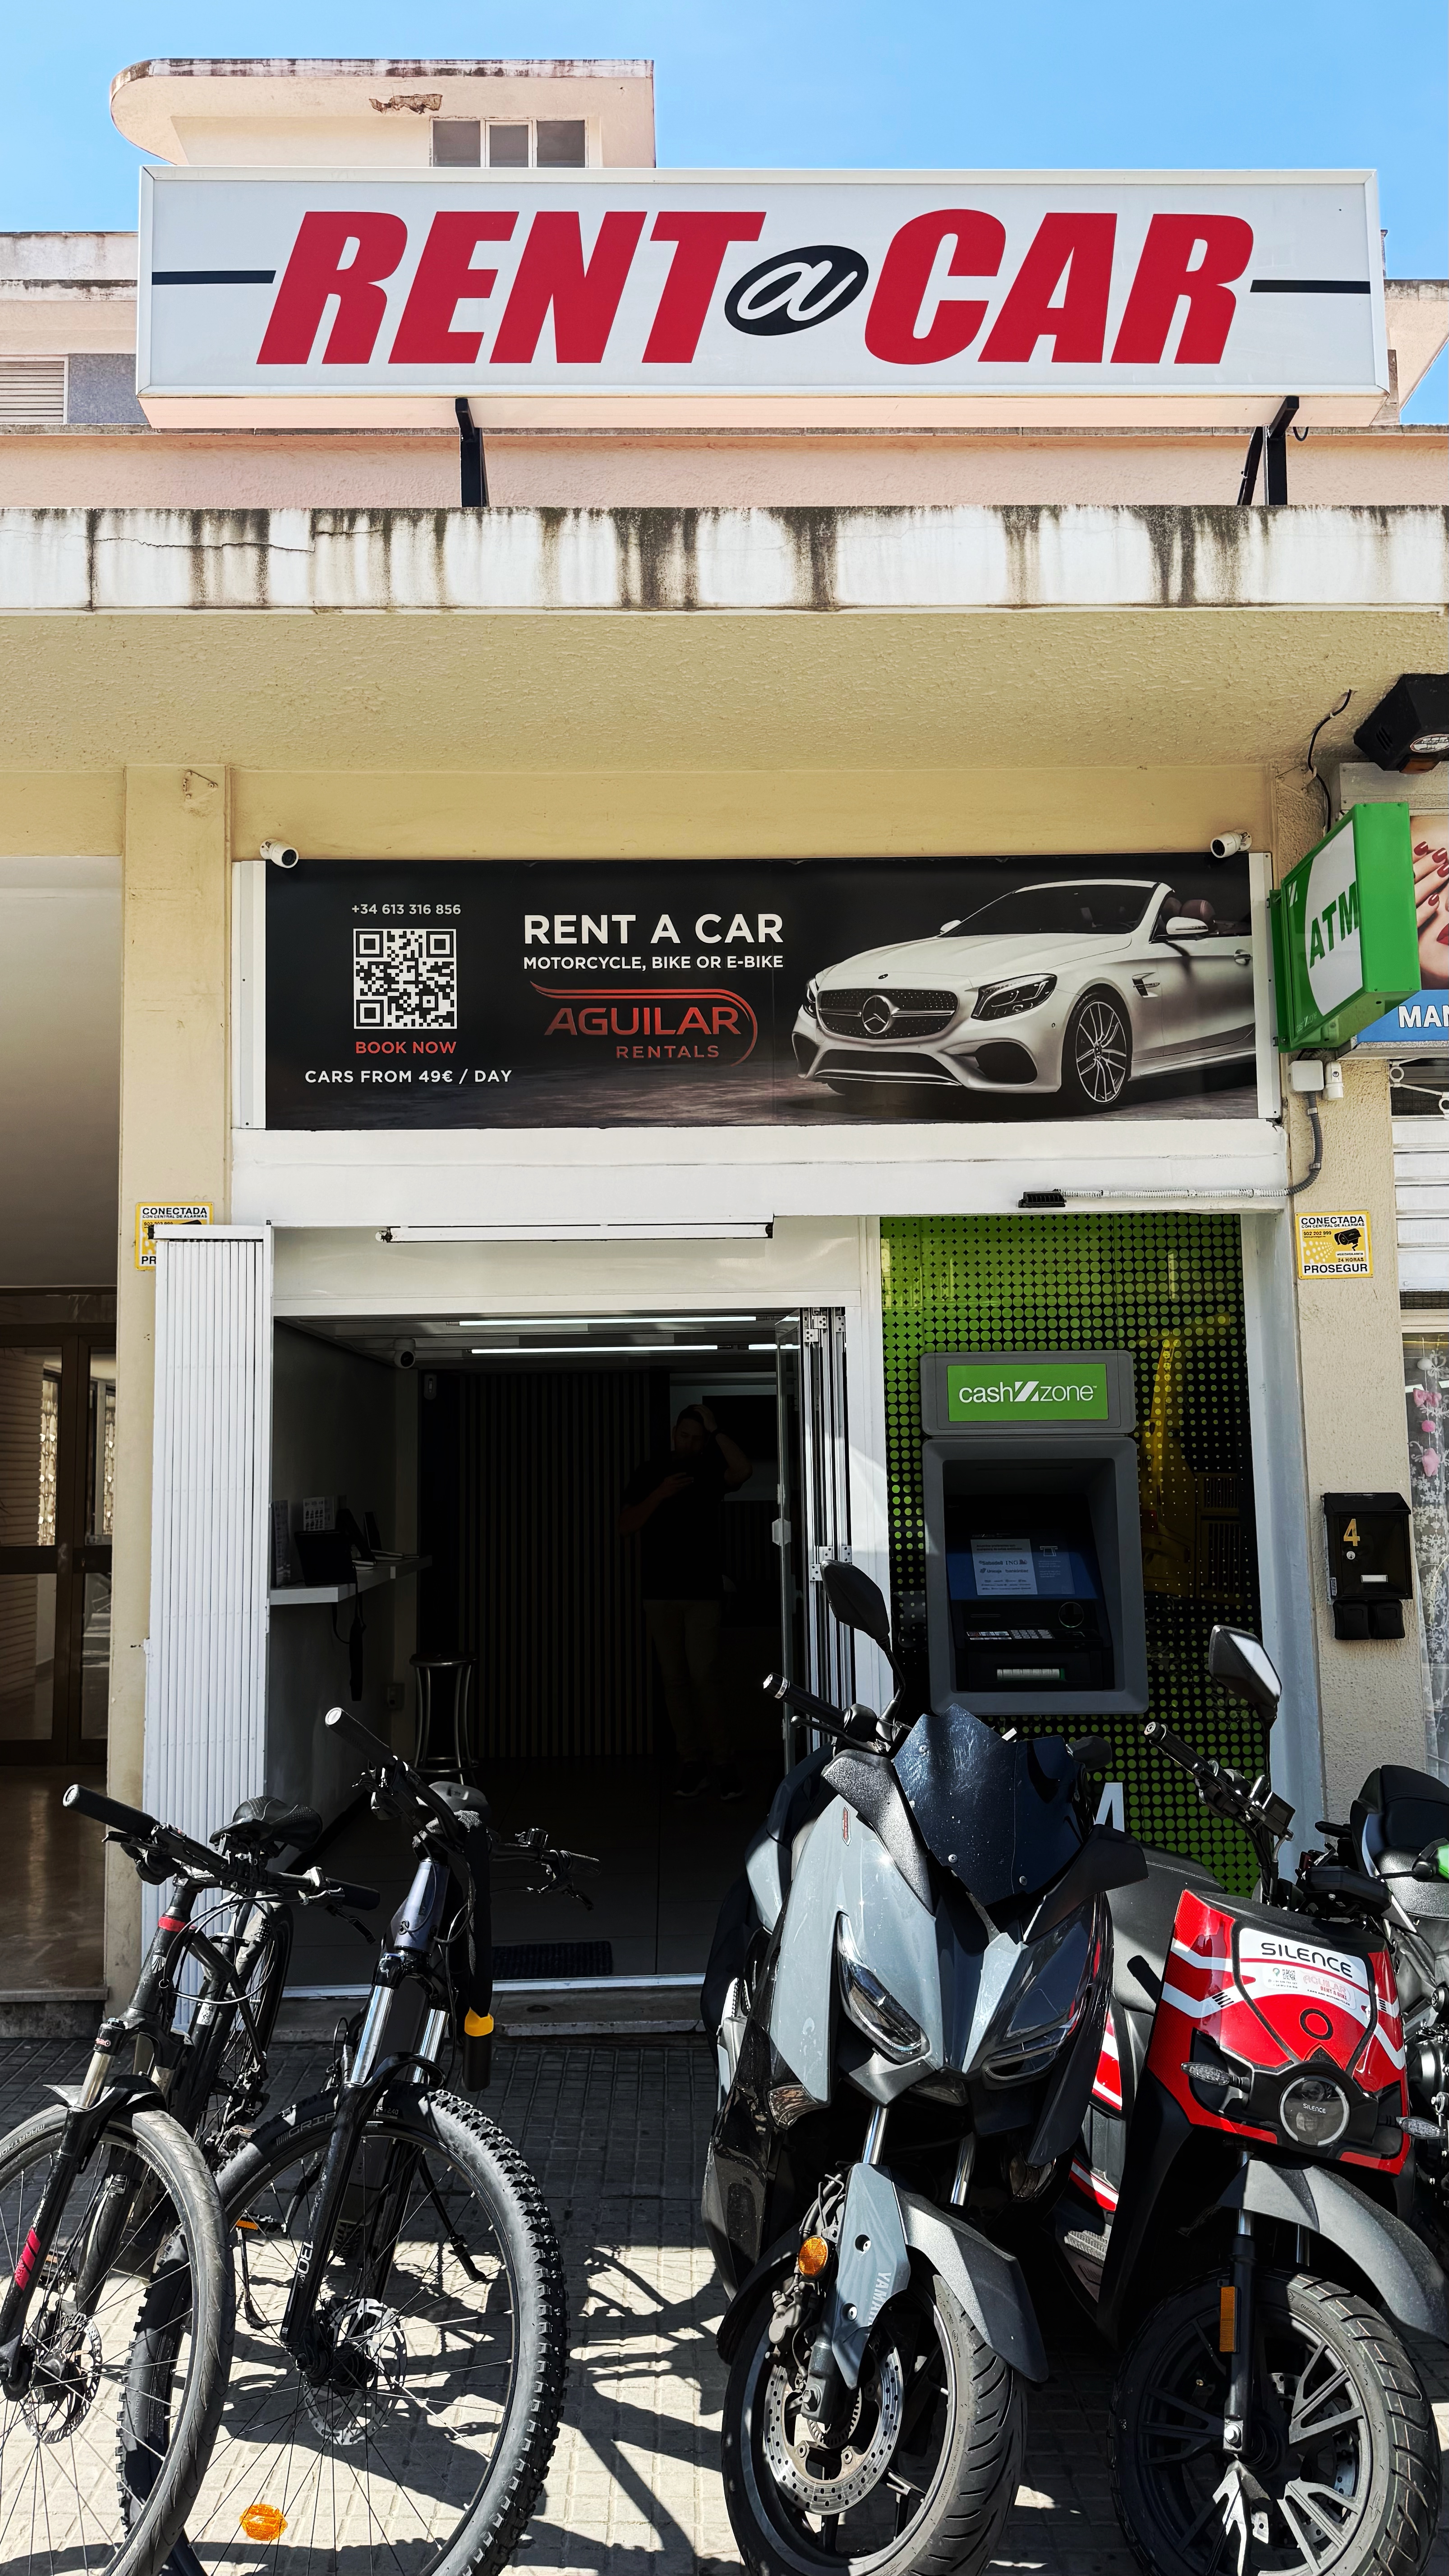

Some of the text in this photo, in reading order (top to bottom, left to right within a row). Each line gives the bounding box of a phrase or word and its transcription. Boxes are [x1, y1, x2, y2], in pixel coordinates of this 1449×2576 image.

[257, 212, 766, 364] RENT
[865, 209, 1254, 364] CAR
[352, 904, 461, 914] +34 613 316 856
[524, 914, 783, 944] RENT A CAR
[1309, 880, 1359, 969] ATM
[524, 956, 783, 971] MOTORCYCLE, BIKE OR E-BIKE
[545, 1007, 741, 1036] AGUILAR
[355, 1041, 456, 1053] BOOK NOW
[616, 1045, 719, 1058] RENTALS
[305, 1069, 512, 1084] CARS FROM 49€ / DAY
[1301, 1216, 1364, 1224] CONECTADA
[1304, 1264, 1368, 1274] PROSEGUR
[1343, 1518, 1360, 1546] 4
[1261, 1942, 1353, 1979] SILENCE
[1303, 2103, 1326, 2114] SILENCE
[0, 2123, 45, 2158] MARATHO
[868, 2272, 892, 2326] YAMAH
